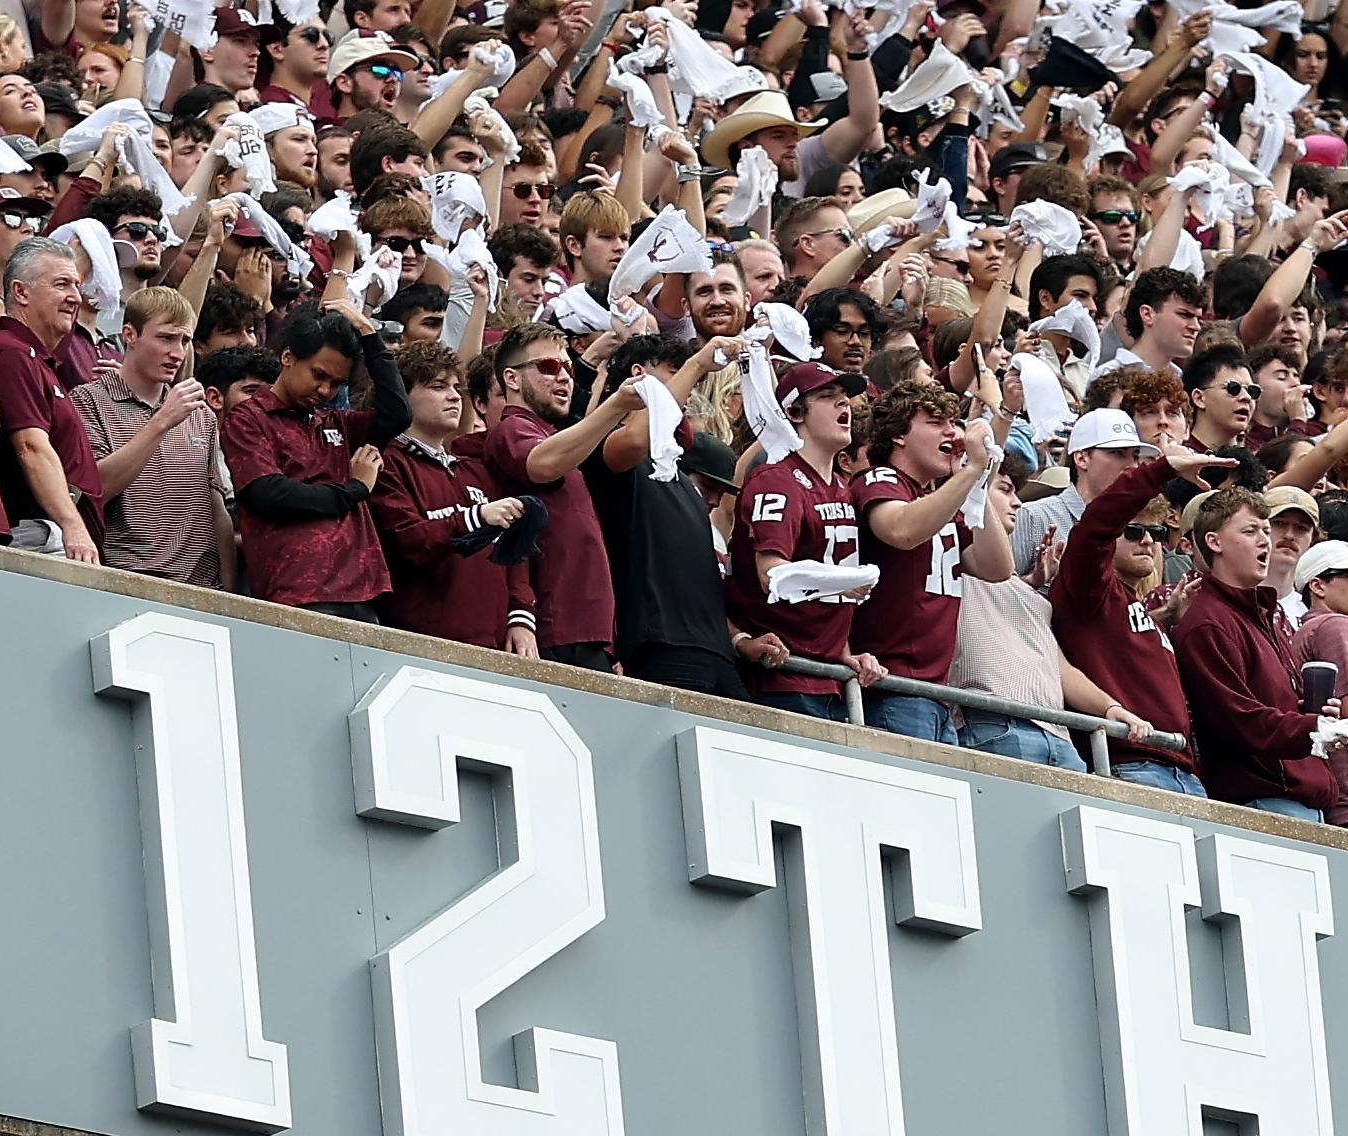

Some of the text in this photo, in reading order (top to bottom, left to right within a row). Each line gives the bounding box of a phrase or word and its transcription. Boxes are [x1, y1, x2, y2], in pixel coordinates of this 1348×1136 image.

[863, 466, 899, 485] 12
[751, 493, 787, 522] 12
[924, 522, 963, 598] 12
